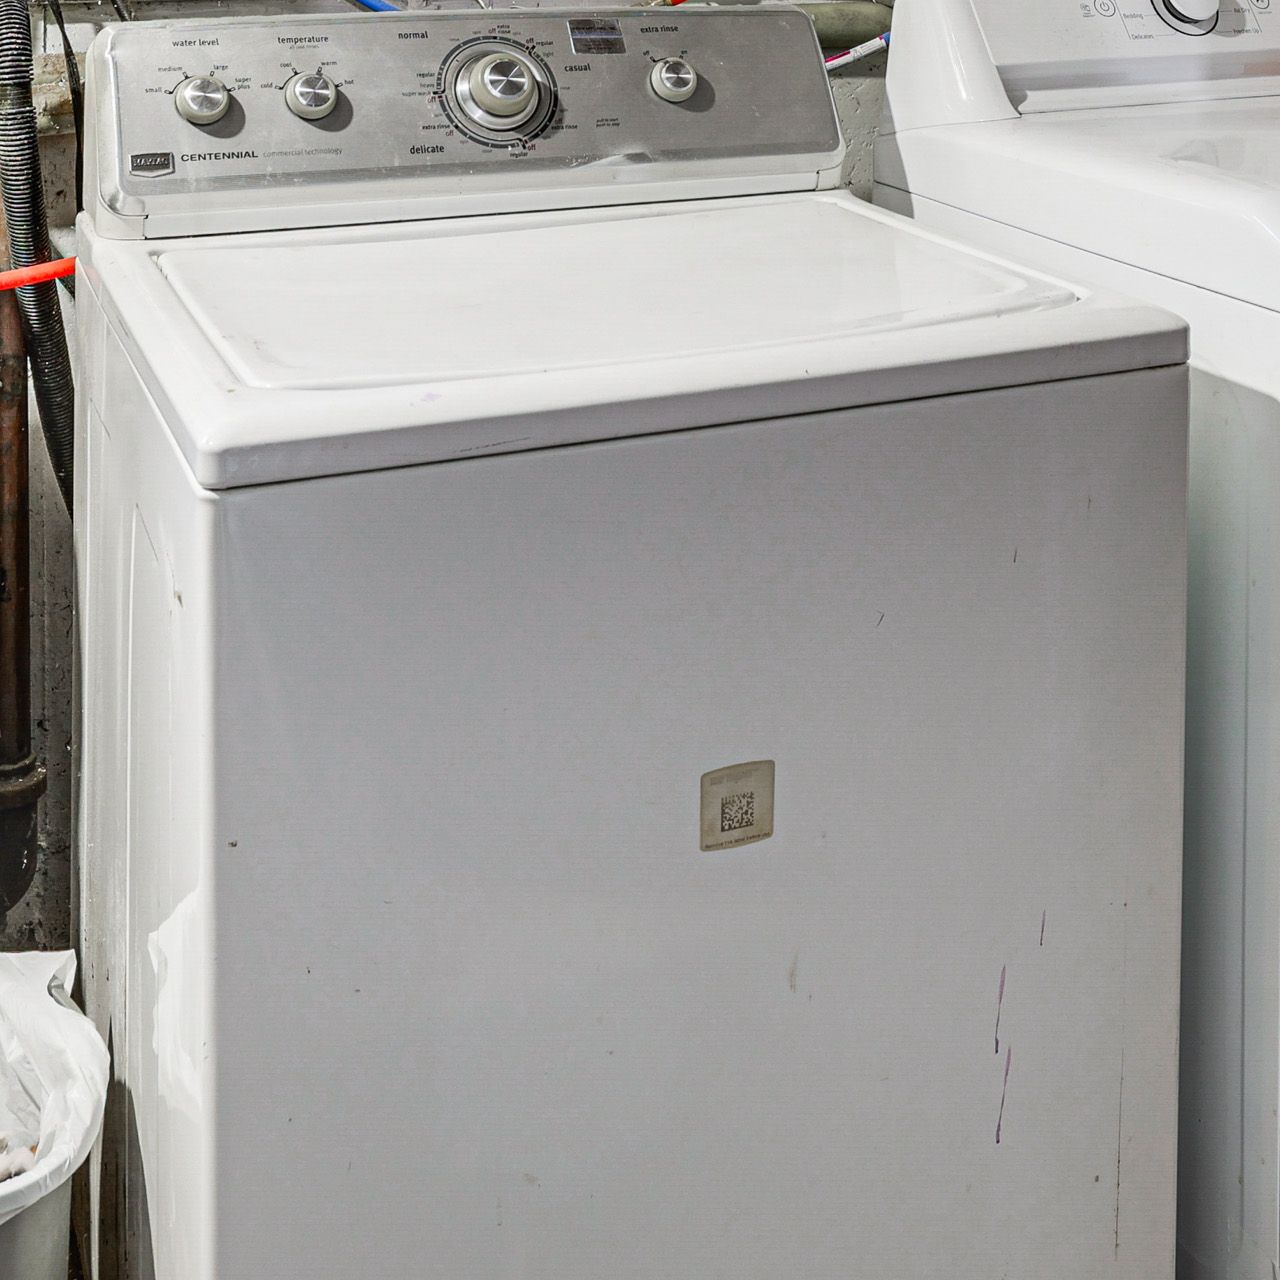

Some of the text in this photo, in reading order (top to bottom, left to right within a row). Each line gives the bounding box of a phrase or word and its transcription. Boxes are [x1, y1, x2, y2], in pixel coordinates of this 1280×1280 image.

[660, 25, 679, 33] rinse
[398, 30, 429, 39] normal
[198, 38, 220, 46] level
[277, 36, 329, 45] temperature
[564, 63, 591, 72] casual
[409, 145, 445, 155] delicate
[181, 150, 259, 162] CENTENNIAL
